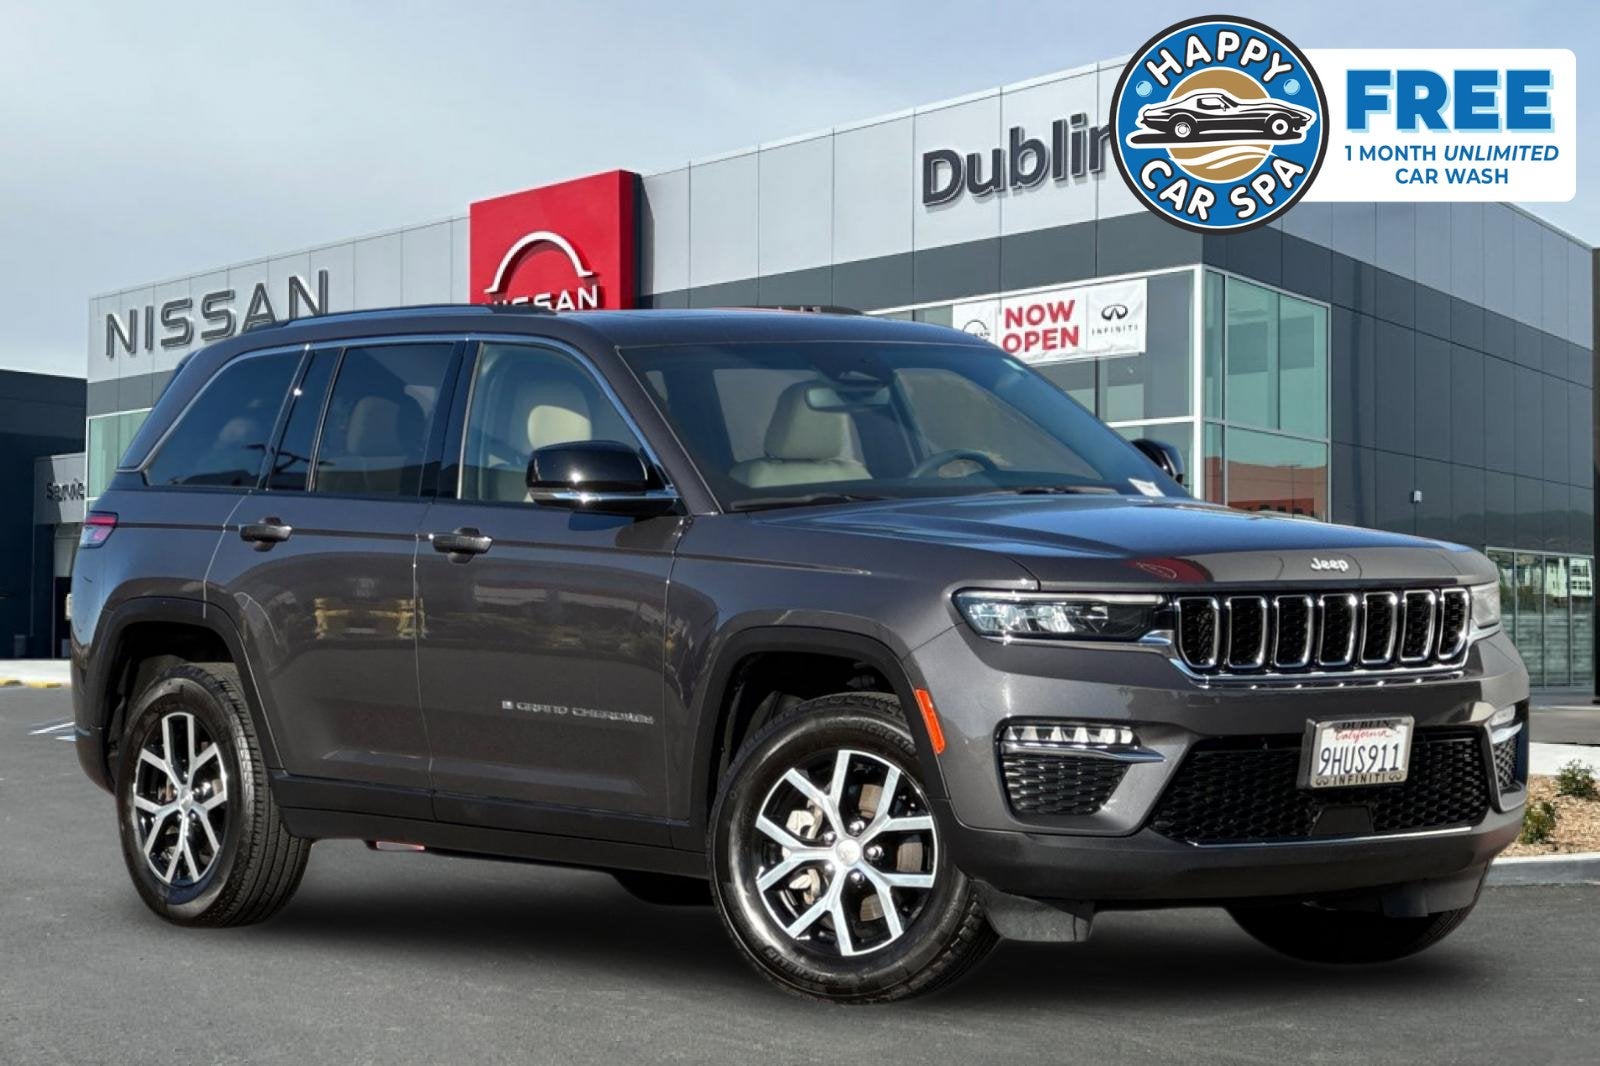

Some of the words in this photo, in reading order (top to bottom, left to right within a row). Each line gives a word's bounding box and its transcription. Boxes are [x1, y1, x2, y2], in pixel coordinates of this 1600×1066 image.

[105, 267, 329, 359] NISSAN
[1004, 299, 1076, 330] NOW
[1002, 325, 1080, 353] OPEN
[1091, 323, 1139, 336] INFINITI
[1311, 557, 1349, 572] Jeep
[1318, 743, 1400, 776] 9HUS911
[1333, 773, 1386, 785] INFINITI
